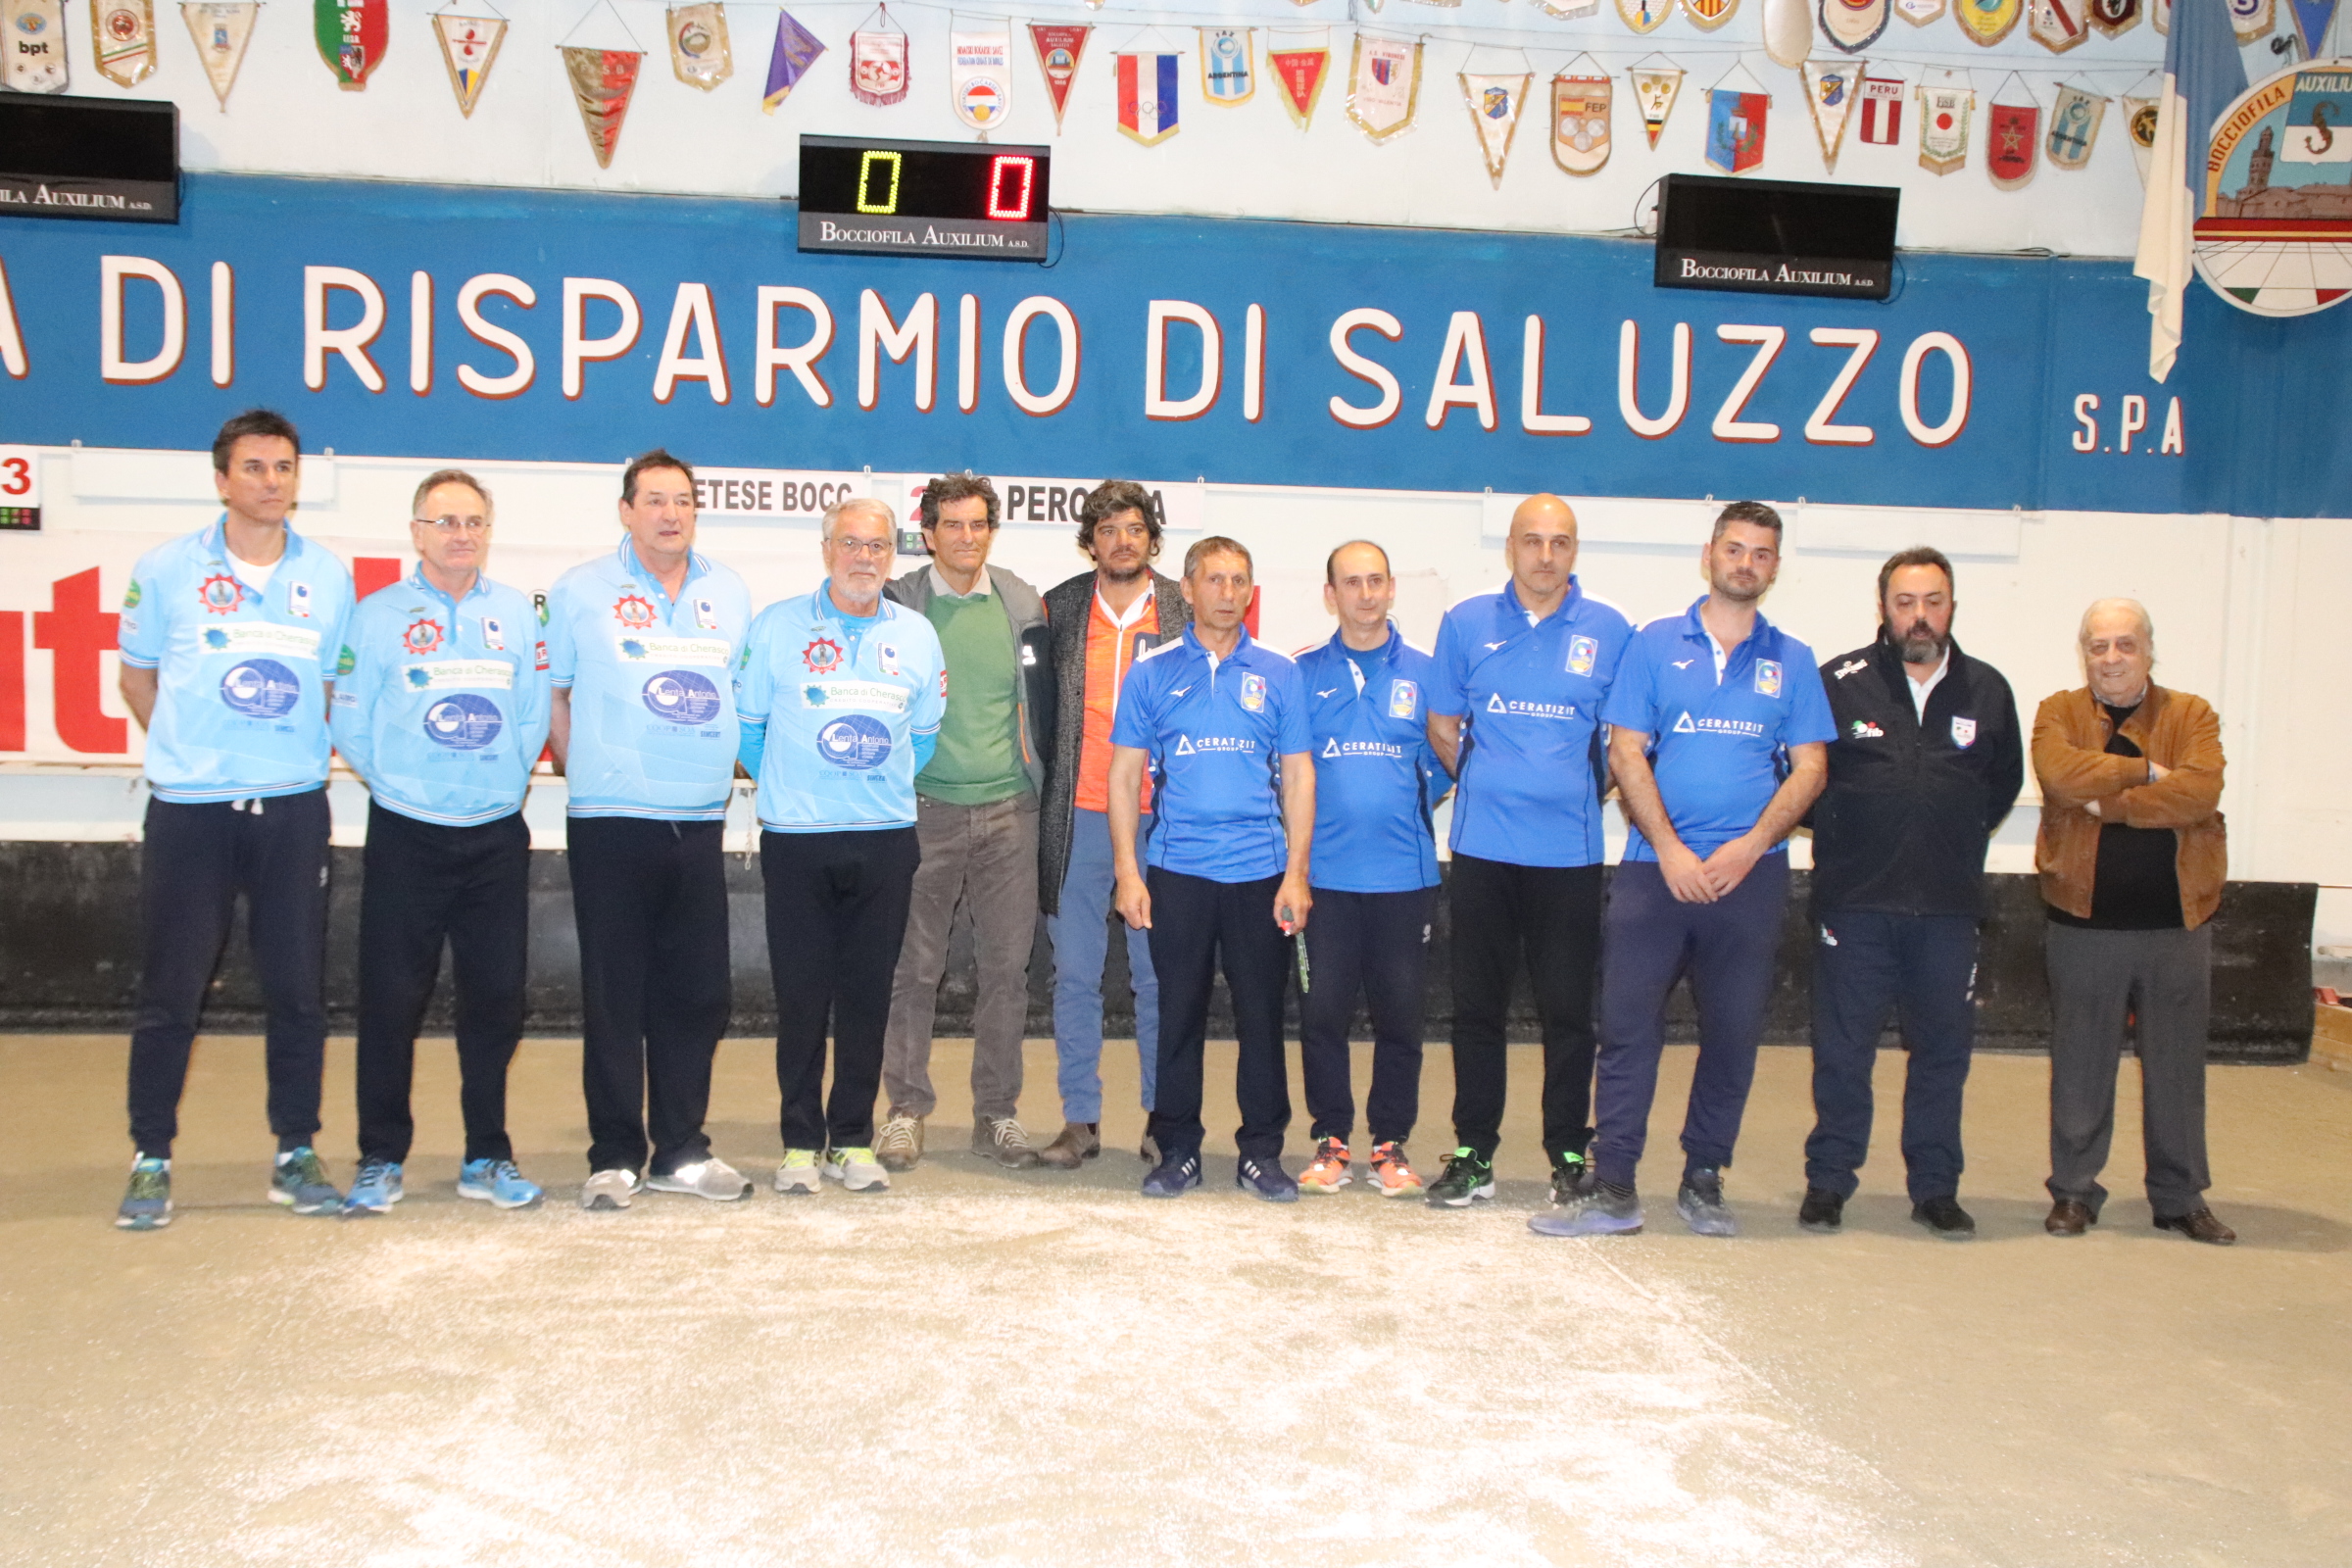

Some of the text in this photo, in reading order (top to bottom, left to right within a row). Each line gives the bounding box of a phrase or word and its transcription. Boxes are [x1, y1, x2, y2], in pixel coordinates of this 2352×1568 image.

[19, 41, 49, 56] bpt
[1208, 71, 1249, 79] ARGENTINA
[1870, 84, 1898, 95] PERU
[1585, 102, 1607, 113] FEP
[2207, 86, 2286, 172] BOCCIOFILA
[858, 150, 902, 214] 0
[988, 156, 1034, 220] 0
[32, 183, 125, 210] AUXILIUM
[820, 220, 916, 245] BOCCIOFILA
[921, 224, 1004, 248] AUXILIUM
[1681, 258, 1770, 282] BOCCIOFILA
[1774, 264, 1852, 286] AUXILIUM
[101, 255, 234, 388] DI
[304, 266, 1082, 418] RISPARMIO
[1145, 300, 1266, 423] DI
[1330, 308, 1974, 449] SALUZZO
[2073, 394, 2184, 456] S.P.A
[2, 458, 31, 495] 3
[649, 642, 678, 653] Banca
[690, 644, 728, 656] Cherasco
[433, 666, 463, 676] Banca
[659, 687, 716, 698] Lenta Antonio
[831, 687, 858, 696] Banca
[1509, 700, 1576, 715] CERATIZIT
[1697, 718, 1764, 733] CERATIZIT
[1867, 727, 1884, 737] fib
[832, 733, 858, 742] Lenta
[1197, 737, 1255, 750] CERATZIT
